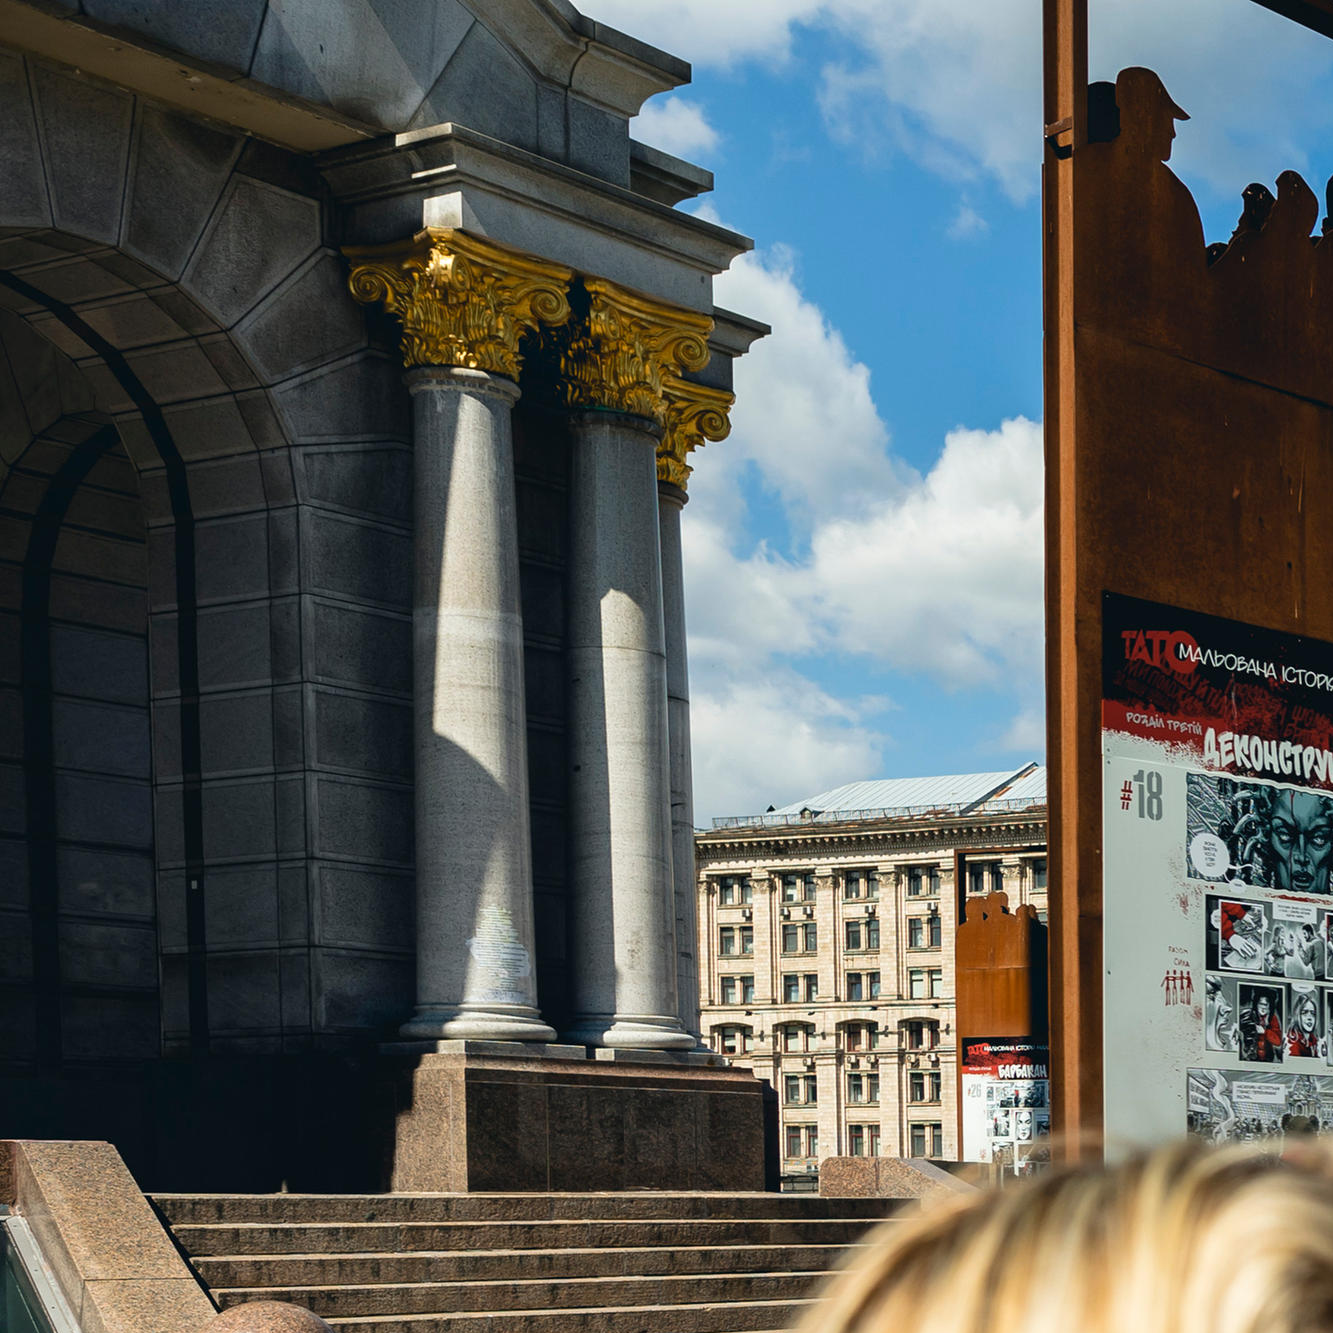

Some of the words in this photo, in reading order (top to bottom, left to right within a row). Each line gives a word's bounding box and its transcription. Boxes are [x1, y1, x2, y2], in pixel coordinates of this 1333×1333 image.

[1121, 629, 1199, 675] ТАТО
[1178, 642, 1277, 680] МАЛЬОВАНА
[1126, 712, 1165, 729] РОЗДІЛ
[1166, 719, 1202, 736] ТРЕТІЙ
[1120, 769, 1163, 821] #18
[998, 1065, 1048, 1078] БАРБАКАН
